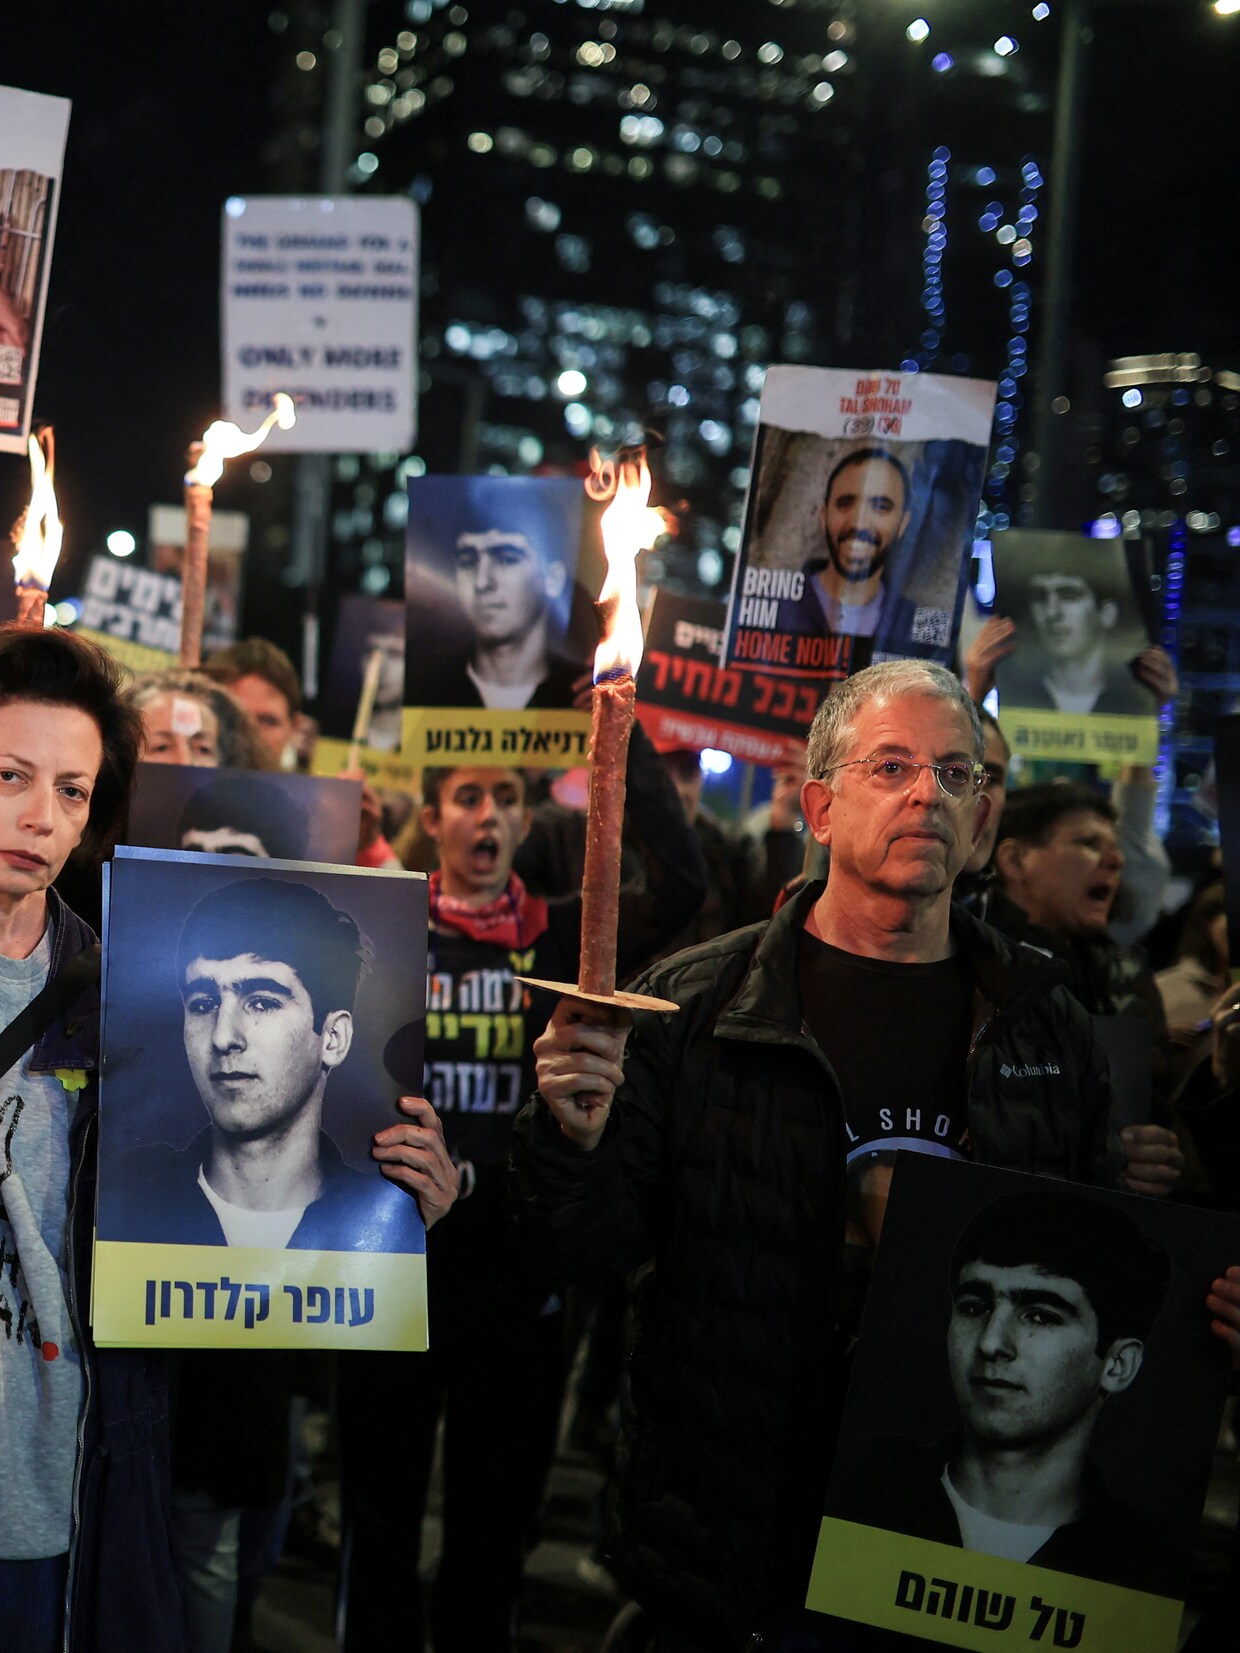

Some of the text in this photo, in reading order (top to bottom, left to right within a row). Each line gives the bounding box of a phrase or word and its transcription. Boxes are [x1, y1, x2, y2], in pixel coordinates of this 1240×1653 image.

[840, 396, 912, 417] TAL SHOHAM
[743, 565, 806, 601] BRING
[738, 600, 780, 629] HIM
[734, 630, 851, 668] HOME NOW!
[648, 650, 744, 708] מחיר
[426, 725, 587, 754] דניאלה גלבוע
[458, 967, 523, 1012] למה
[426, 1012, 524, 1059] עדיי
[145, 1276, 375, 1329] עופר קלדרון
[894, 1569, 1086, 1649] טל שוהם
